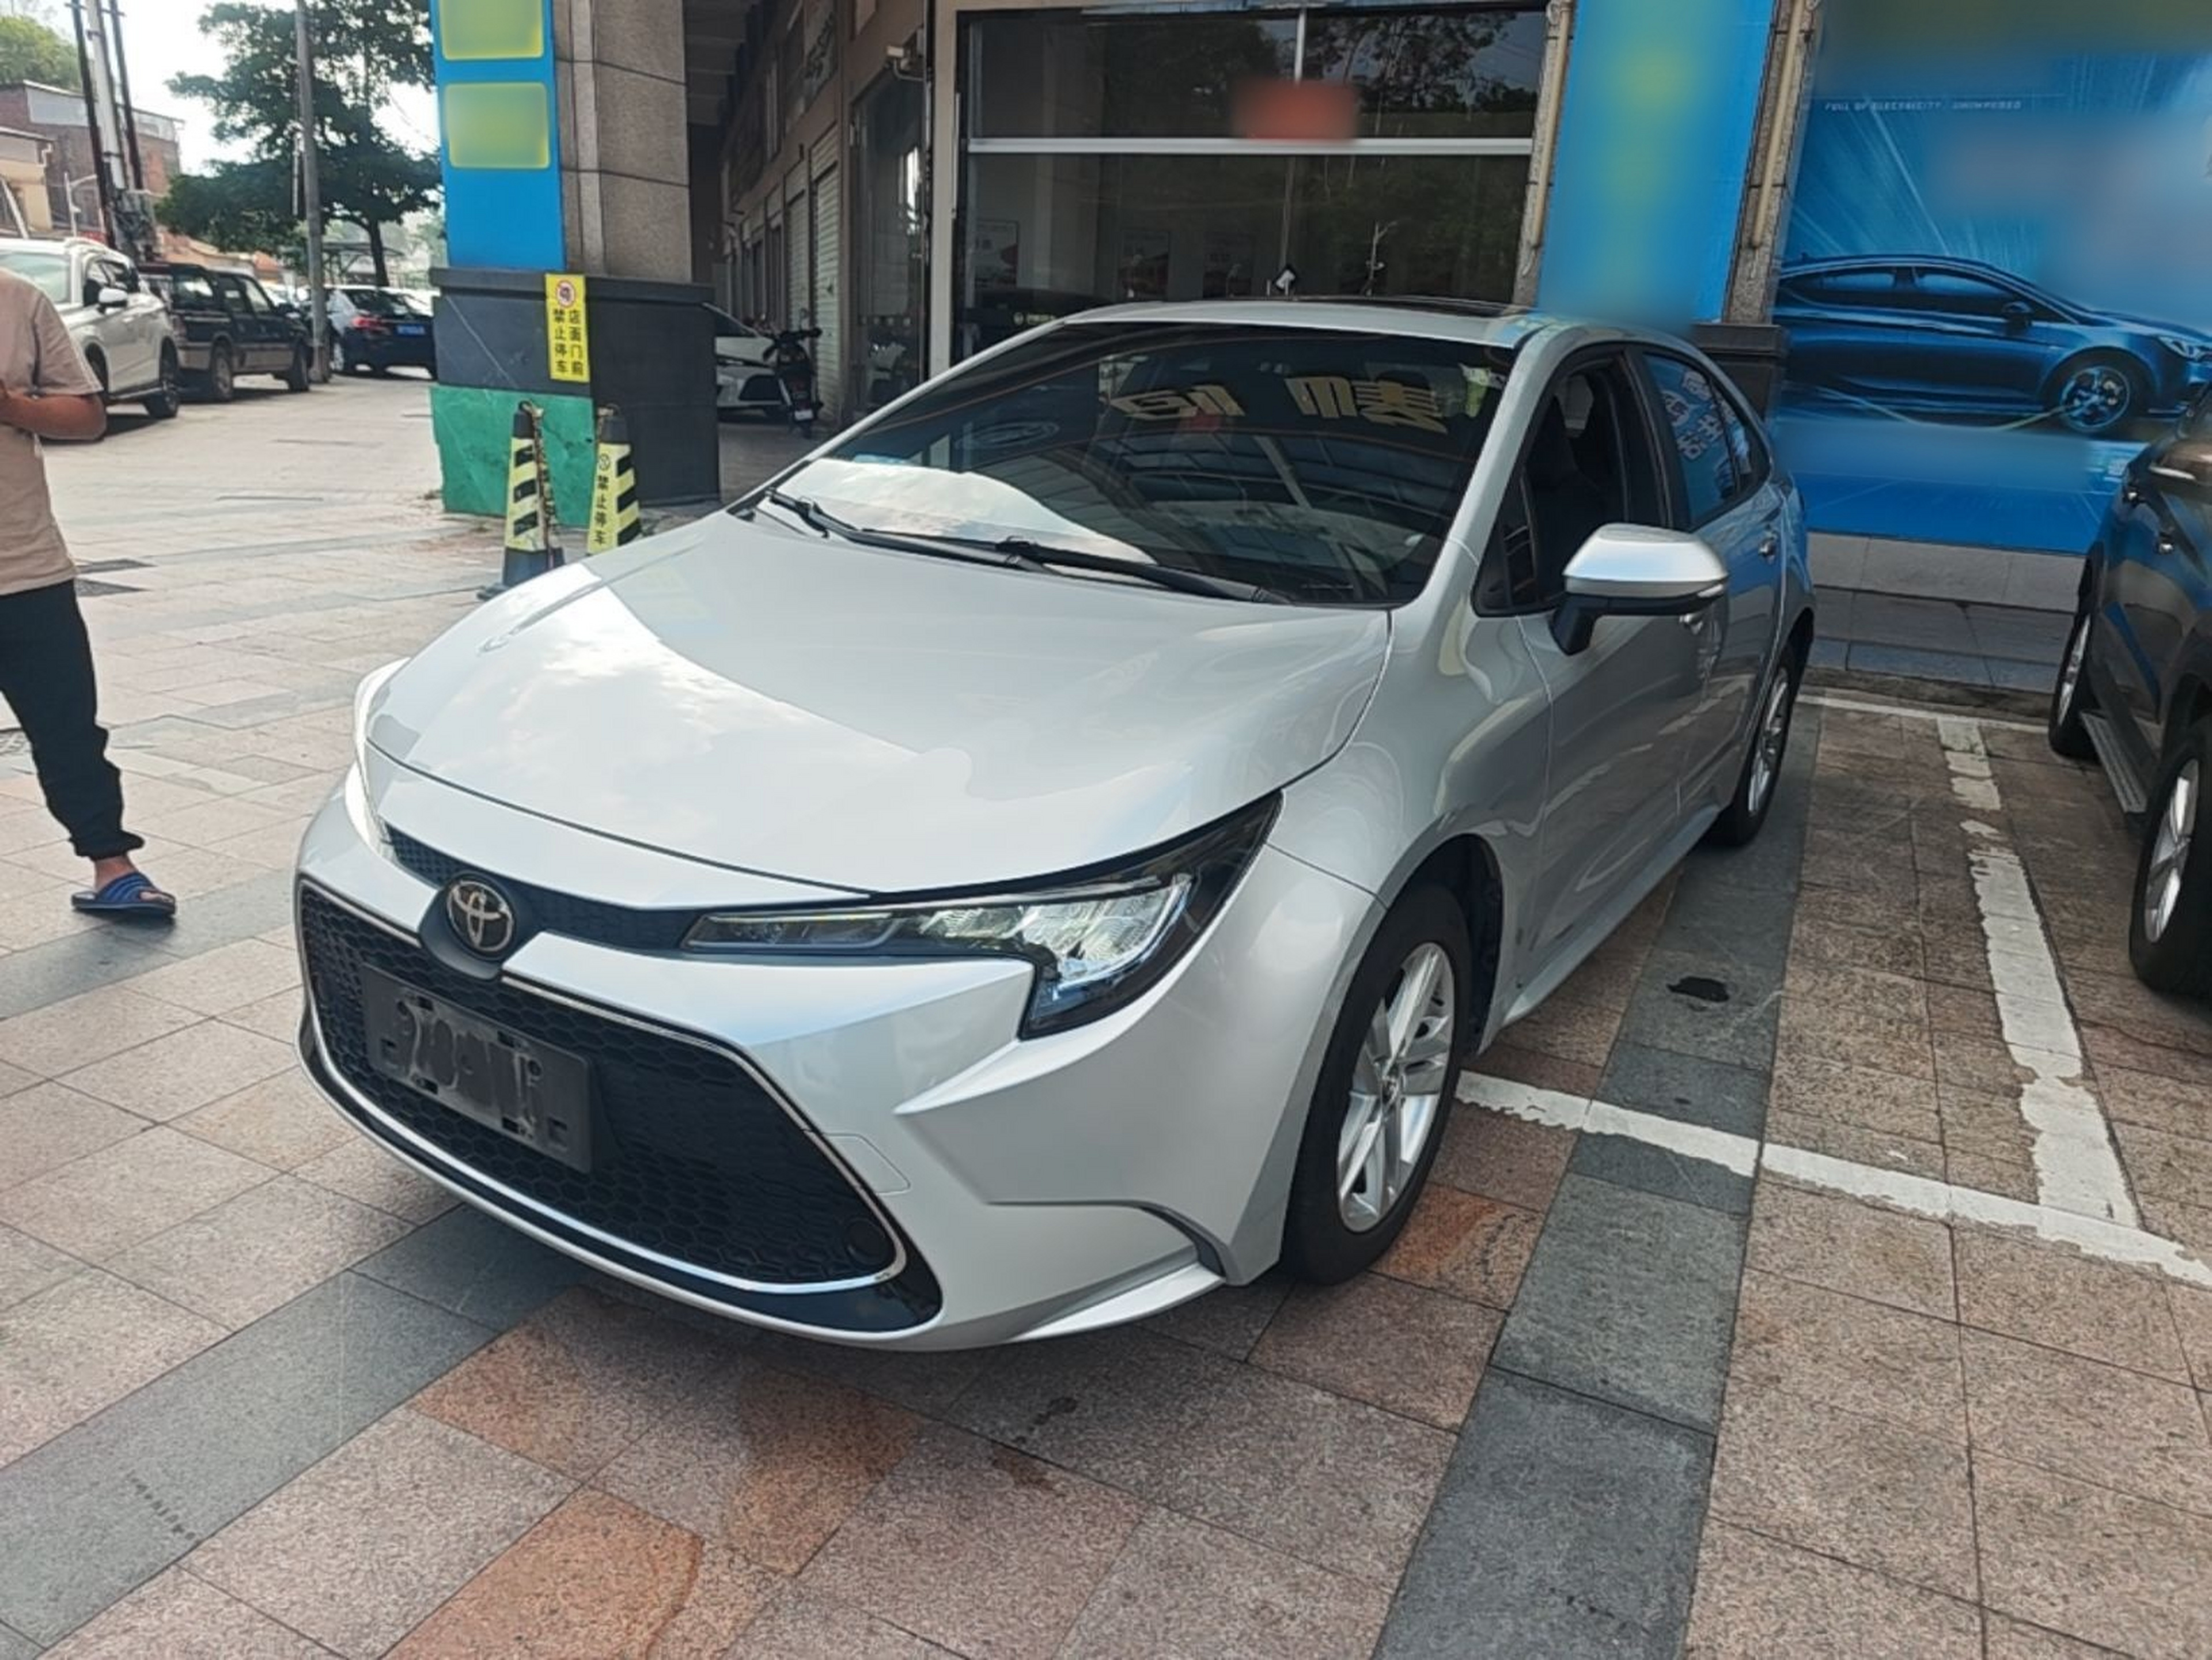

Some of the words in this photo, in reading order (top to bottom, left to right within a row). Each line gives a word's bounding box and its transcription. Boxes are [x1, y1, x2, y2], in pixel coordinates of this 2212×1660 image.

[553, 308, 568, 372] 禁止停车
[593, 475, 609, 546] 禁止停车
